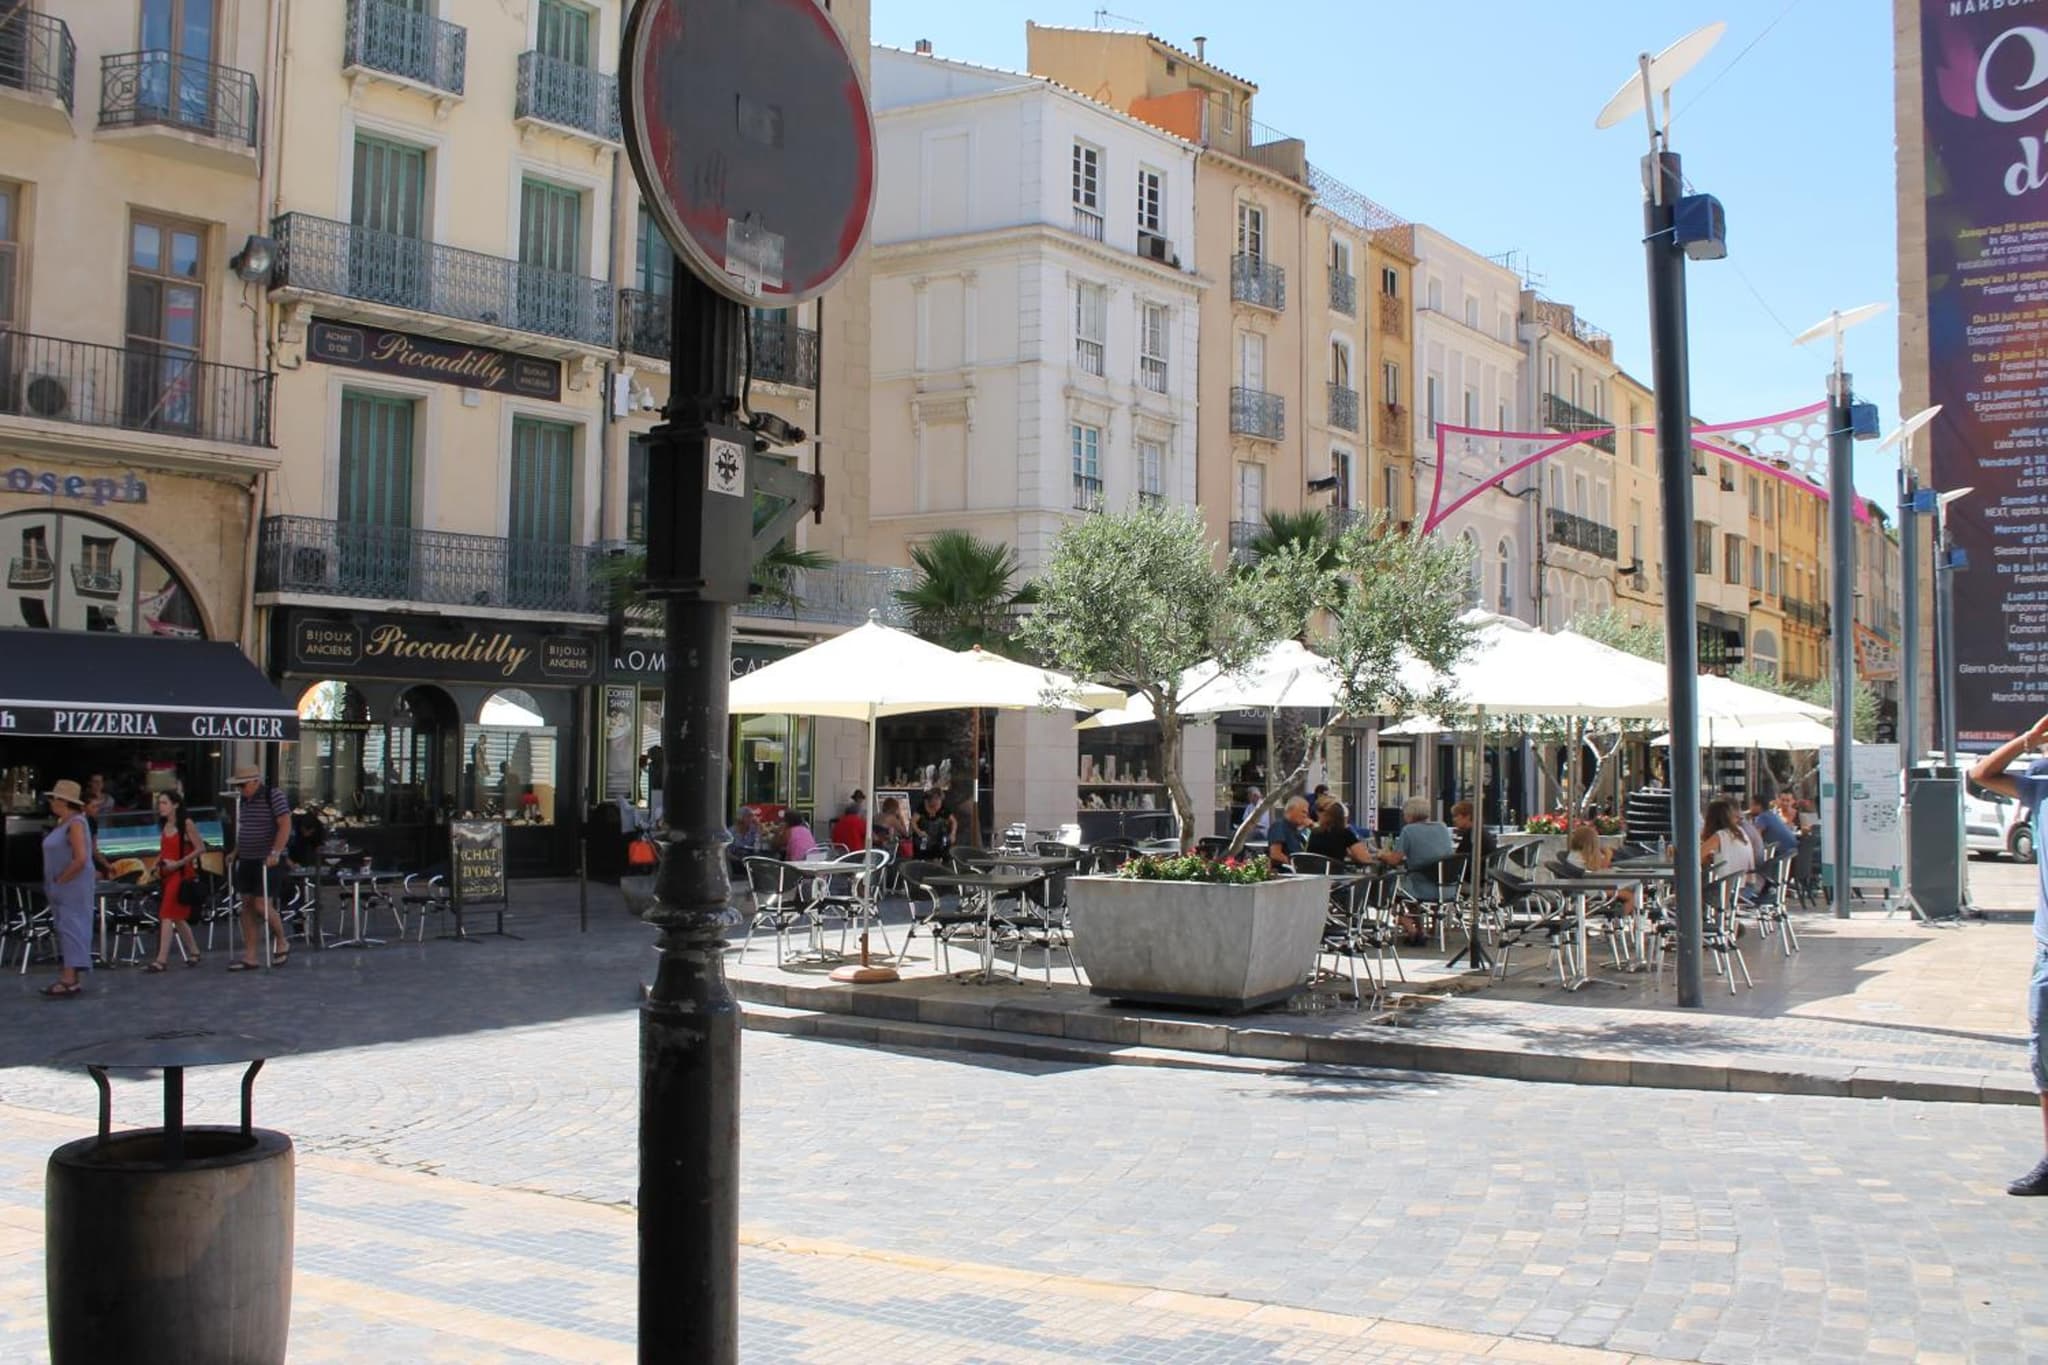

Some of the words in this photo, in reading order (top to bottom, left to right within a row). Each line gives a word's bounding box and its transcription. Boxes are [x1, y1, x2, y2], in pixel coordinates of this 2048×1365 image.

[1992, 247, 2005, 255] Art
[1983, 284, 2018, 295] Festival
[2020, 282, 2038, 291] des
[2014, 294, 2026, 303] de
[1966, 323, 2014, 336] Exposition
[371, 333, 506, 387] Piccadilly
[1984, 373, 1997, 383] de
[1966, 392, 1980, 401] Du
[1974, 401, 2022, 413] Exposition
[2016, 438, 2034, 448] des
[1978, 457, 2022, 468] Vendredi
[2023, 468, 2034, 476] et
[2001, 495, 2039, 506] Samedi
[1994, 524, 2038, 534] Mercredi
[1997, 564, 2012, 573] Du
[2021, 564, 2035, 573] au
[2007, 592, 2036, 602] Lundi
[2019, 613, 2037, 623] Feu
[2009, 625, 2046, 634] Concert
[306, 630, 353, 642] BIJOUX
[305, 644, 352, 656] ANCIENS
[366, 624, 530, 677] Piccadilly
[549, 645, 587, 656] BIJOUX
[2007, 642, 2035, 652] Mardi
[2019, 653, 2037, 663] Feu
[549, 658, 588, 669] ANCIENS
[1959, 664, 1986, 674] Glenn
[2025, 682, 2036, 691] et
[608, 689, 634, 698] COFFEE
[1991, 693, 2026, 702] Marché
[2027, 694, 2045, 702] des
[609, 700, 630, 708] SHOP
[54, 711, 158, 735] PIZZERIA
[191, 716, 284, 738] GLACIER
